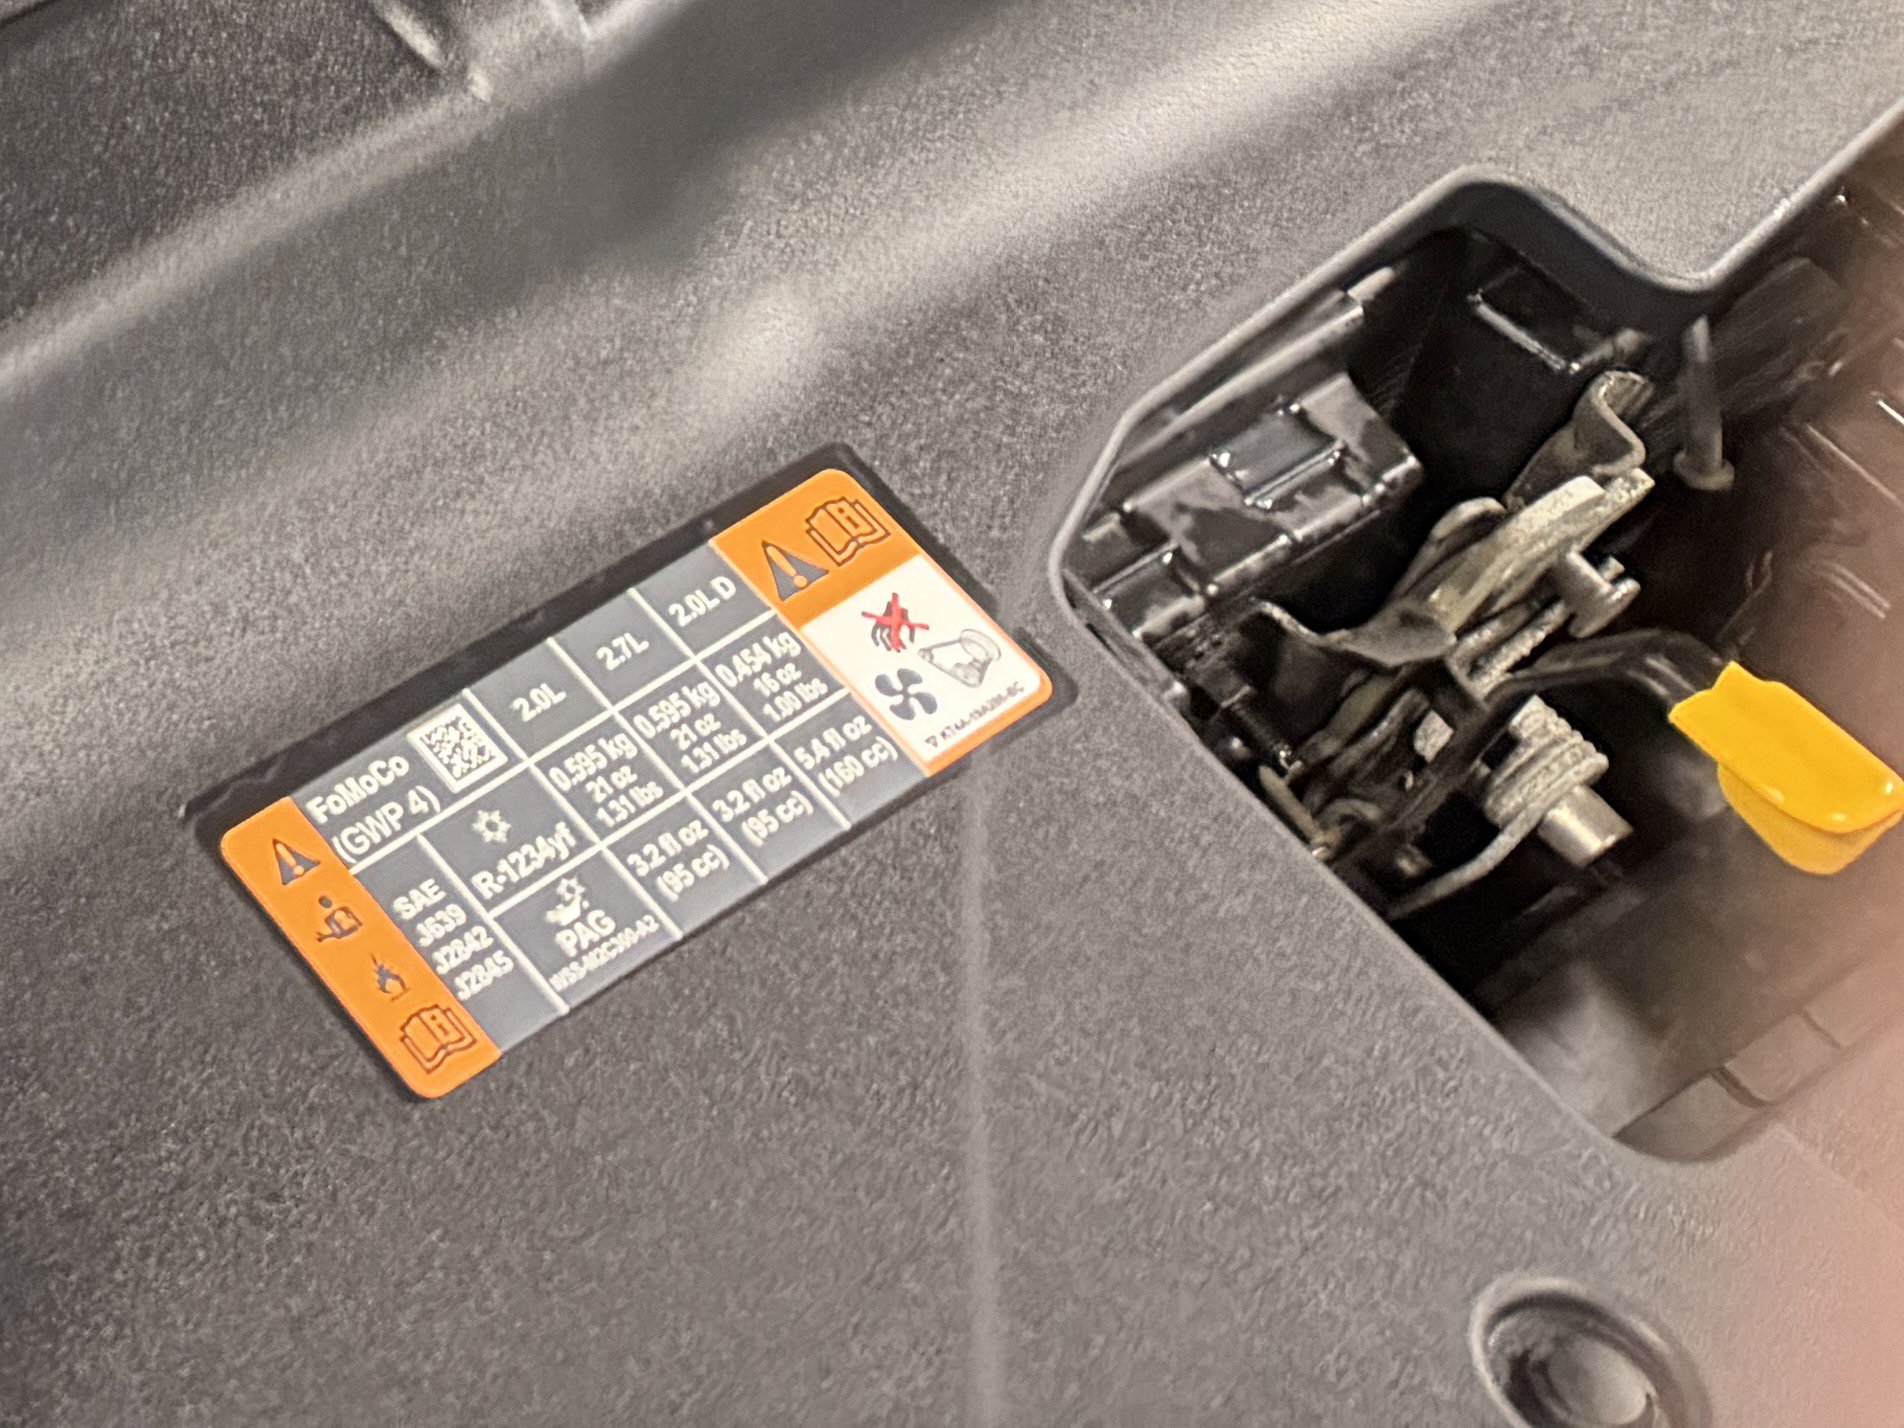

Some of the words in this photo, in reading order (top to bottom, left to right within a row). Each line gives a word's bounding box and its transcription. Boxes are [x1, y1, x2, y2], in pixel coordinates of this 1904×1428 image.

[668, 589, 721, 628] 2.0L
[710, 576, 736, 600] D
[595, 632, 650, 671] 2.7L
[762, 630, 802, 659] kg
[510, 682, 567, 723] 2.0L
[752, 670, 780, 698] 16
[776, 662, 802, 686] oz
[794, 677, 829, 703] lbs
[632, 691, 692, 740] 0.595
[682, 680, 721, 709] kg
[669, 723, 698, 751] 21
[694, 712, 722, 736] oz
[548, 743, 608, 792] 0.595
[597, 732, 638, 761] kg
[680, 742, 720, 774] 1.31
[712, 728, 748, 754] lbs
[793, 737, 831, 771] 5.4
[843, 715, 873, 742] oz
[817, 754, 865, 798] (160
[860, 734, 899, 769] cc)
[305, 755, 410, 825] FoMoCo
[585, 775, 615, 804] 21
[610, 765, 638, 790] oz
[594, 794, 637, 828] 1.31
[628, 780, 664, 807] lbs
[711, 789, 751, 824] 3.2
[761, 766, 793, 794] oz
[331, 801, 405, 865] (GWP
[407, 784, 442, 814] 4)
[741, 807, 781, 848] (95
[774, 789, 815, 824] cc)
[471, 821, 577, 900] R-1234yf
[626, 842, 667, 878] 3.2
[677, 819, 710, 847] oz
[655, 861, 695, 904] (95
[690, 843, 731, 878] cc)
[392, 878, 446, 920] SAE
[416, 903, 467, 948] J639
[431, 926, 494, 975] J2842
[554, 909, 616, 958] PAG
[455, 950, 515, 1001] J2845
